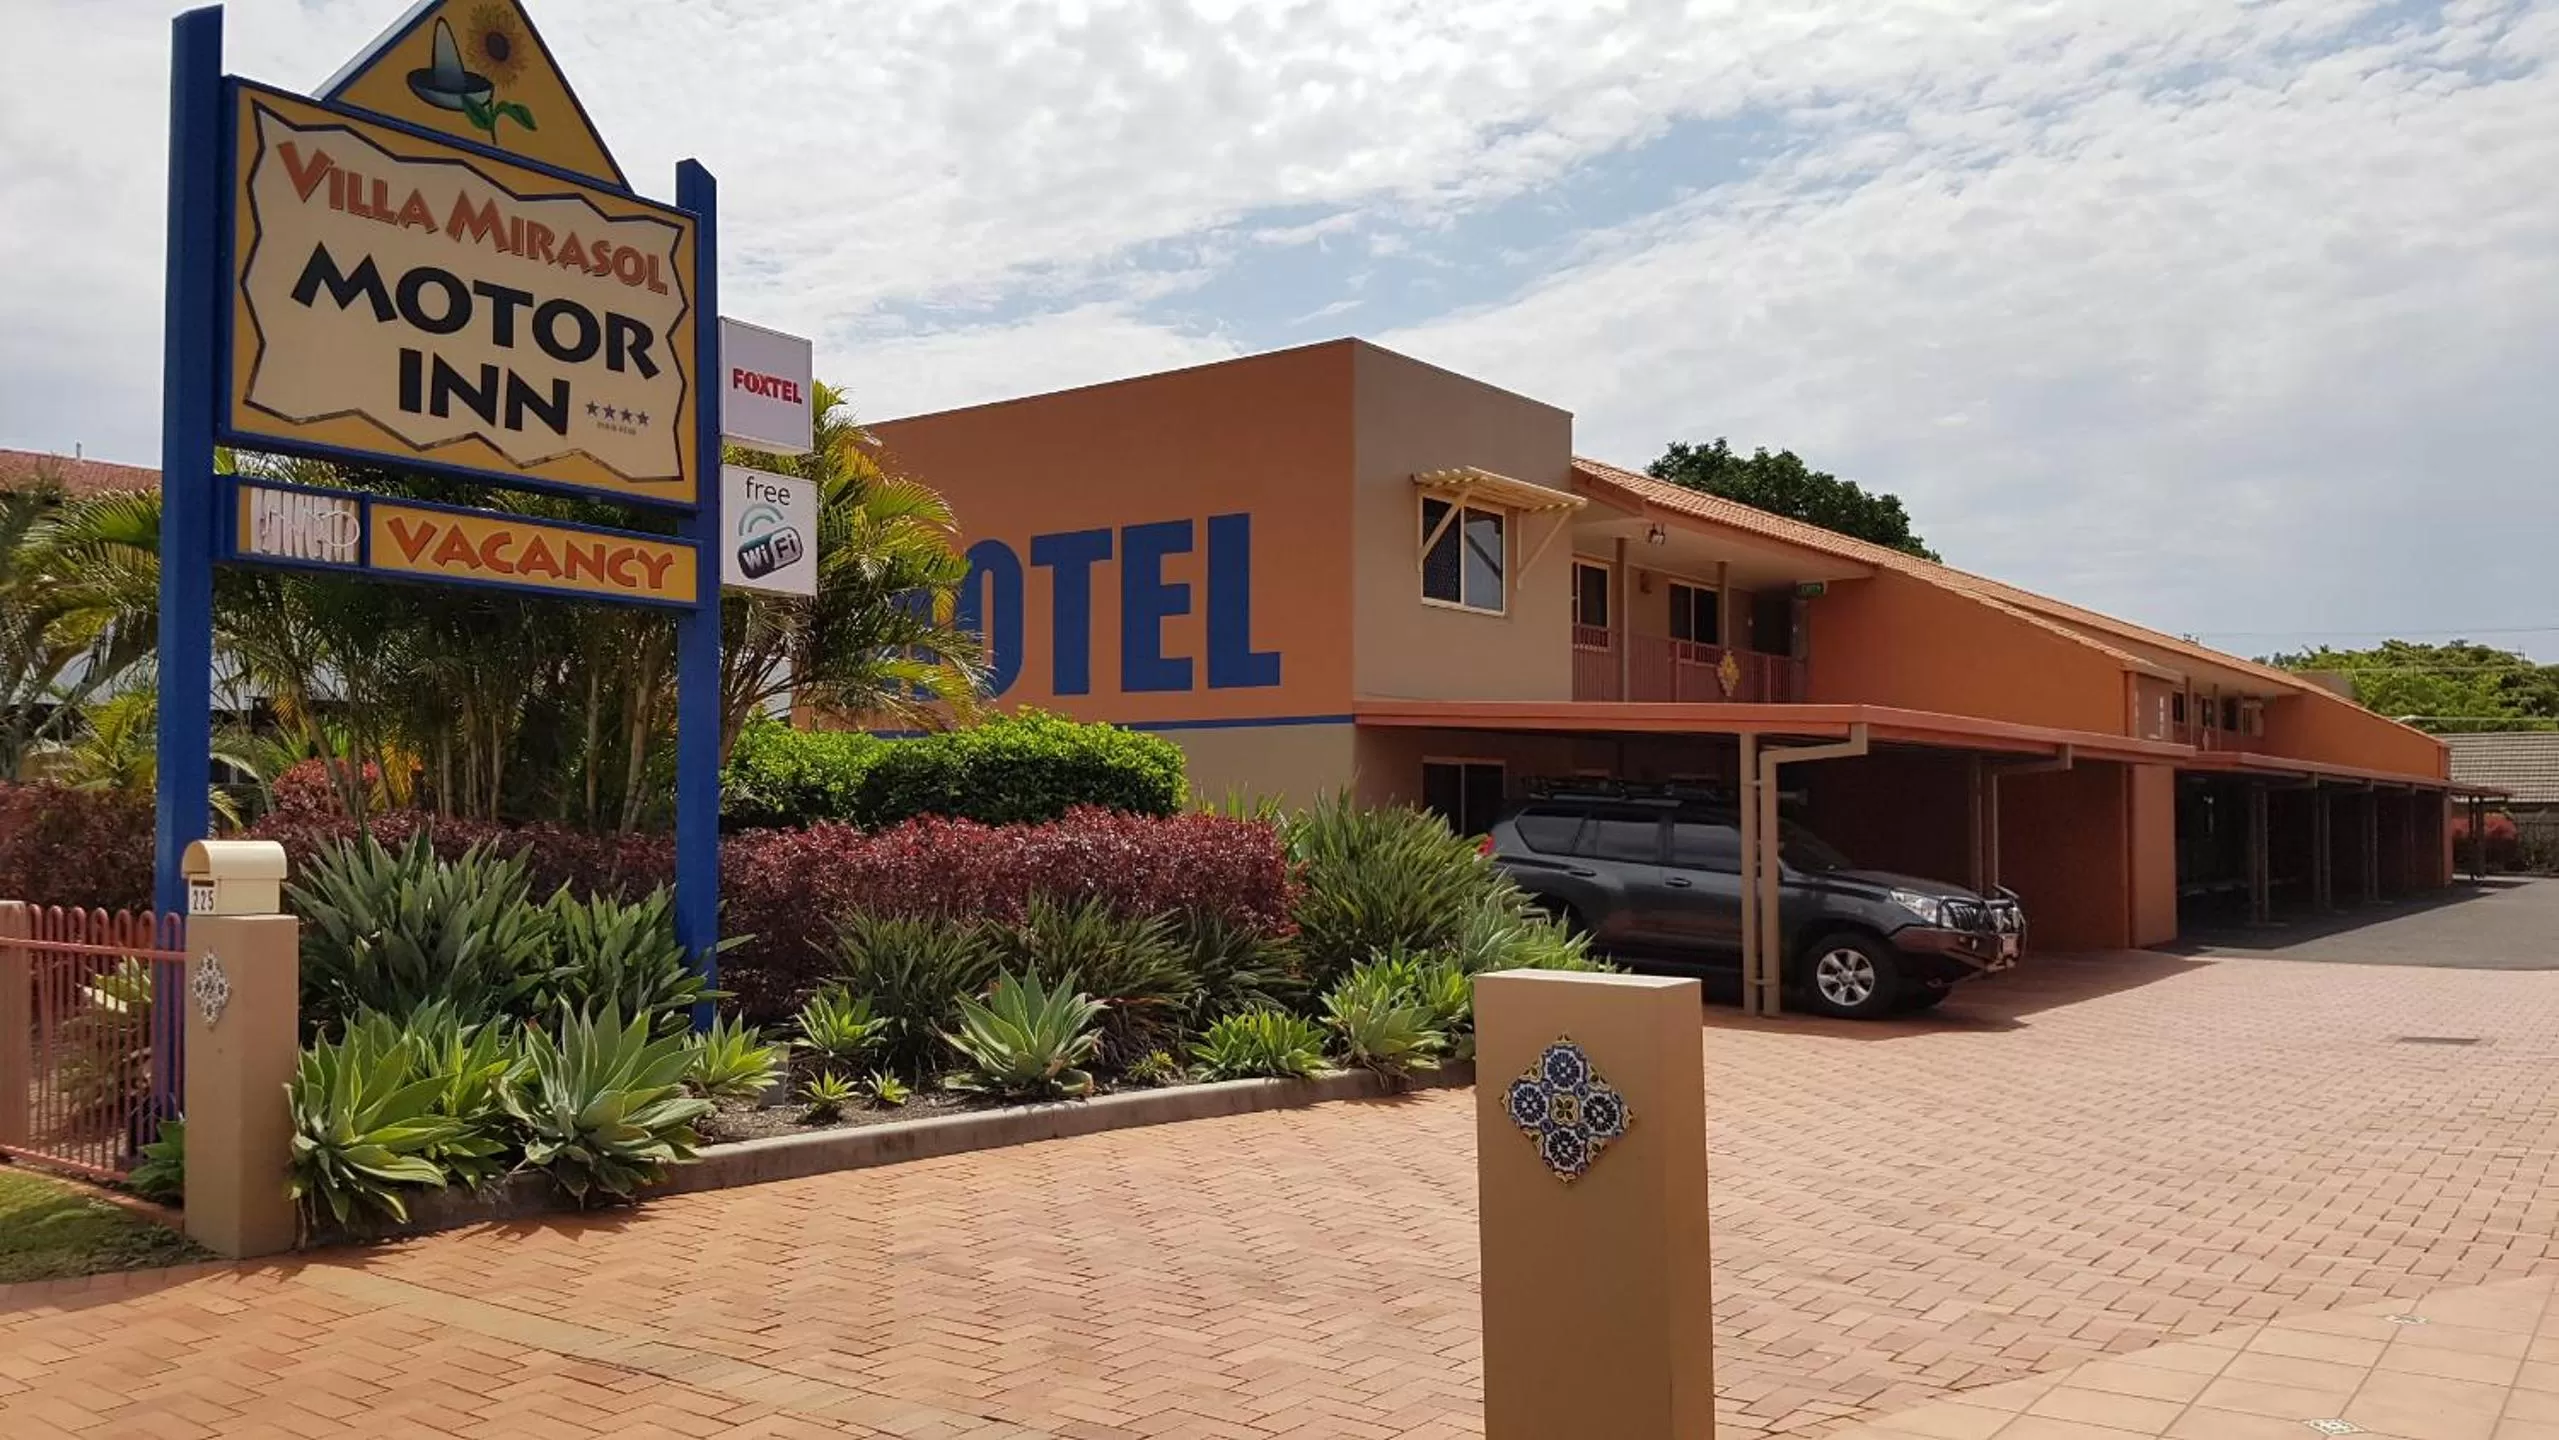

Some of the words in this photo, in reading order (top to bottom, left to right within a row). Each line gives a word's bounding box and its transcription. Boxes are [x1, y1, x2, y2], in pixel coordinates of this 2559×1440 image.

[277, 141, 438, 233] VILLA
[446, 189, 668, 295] MIRASOL
[291, 241, 660, 379] MOTOR
[399, 348, 570, 435] INN
[733, 368, 803, 404] FOXTEL
[746, 476, 791, 506] free
[387, 516, 673, 588] VACANCY
[870, 513, 1280, 702] OTEL
[193, 889, 214, 911] 225
